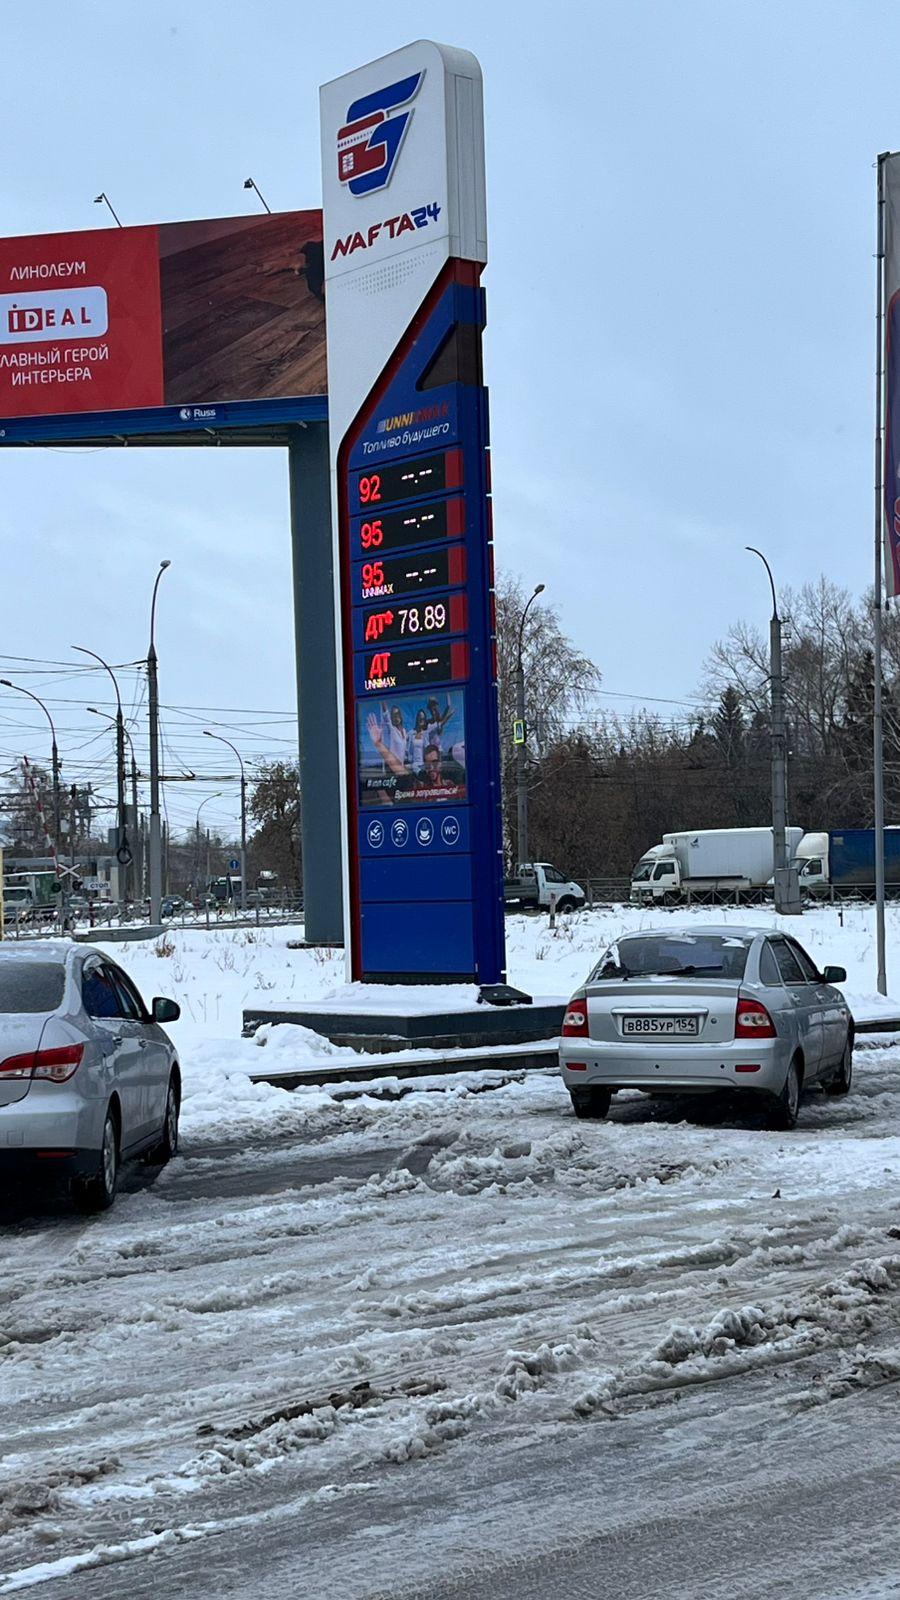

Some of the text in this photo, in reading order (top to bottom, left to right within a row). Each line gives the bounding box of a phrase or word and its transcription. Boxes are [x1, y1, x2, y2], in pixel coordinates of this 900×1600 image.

[331, 202, 441, 261] NAFTA24
[10, 261, 86, 281] ЛИНОЛЕУМ
[0, 344, 109, 368] ЛАВНЫЙ ГЕРОЙ
[12, 367, 92, 386] ИНТЕРЬЕРА
[194, 409, 216, 418] Russ
[363, 423, 450, 454] Топливо будущего
[360, 475, 381, 503] 92
[361, 520, 383, 549] 95
[362, 561, 385, 587] 95
[398, 604, 446, 634] 78.89
[370, 652, 391, 679] ДТ
[444, 825, 457, 835] WC
[675, 1018, 695, 1029] 154
